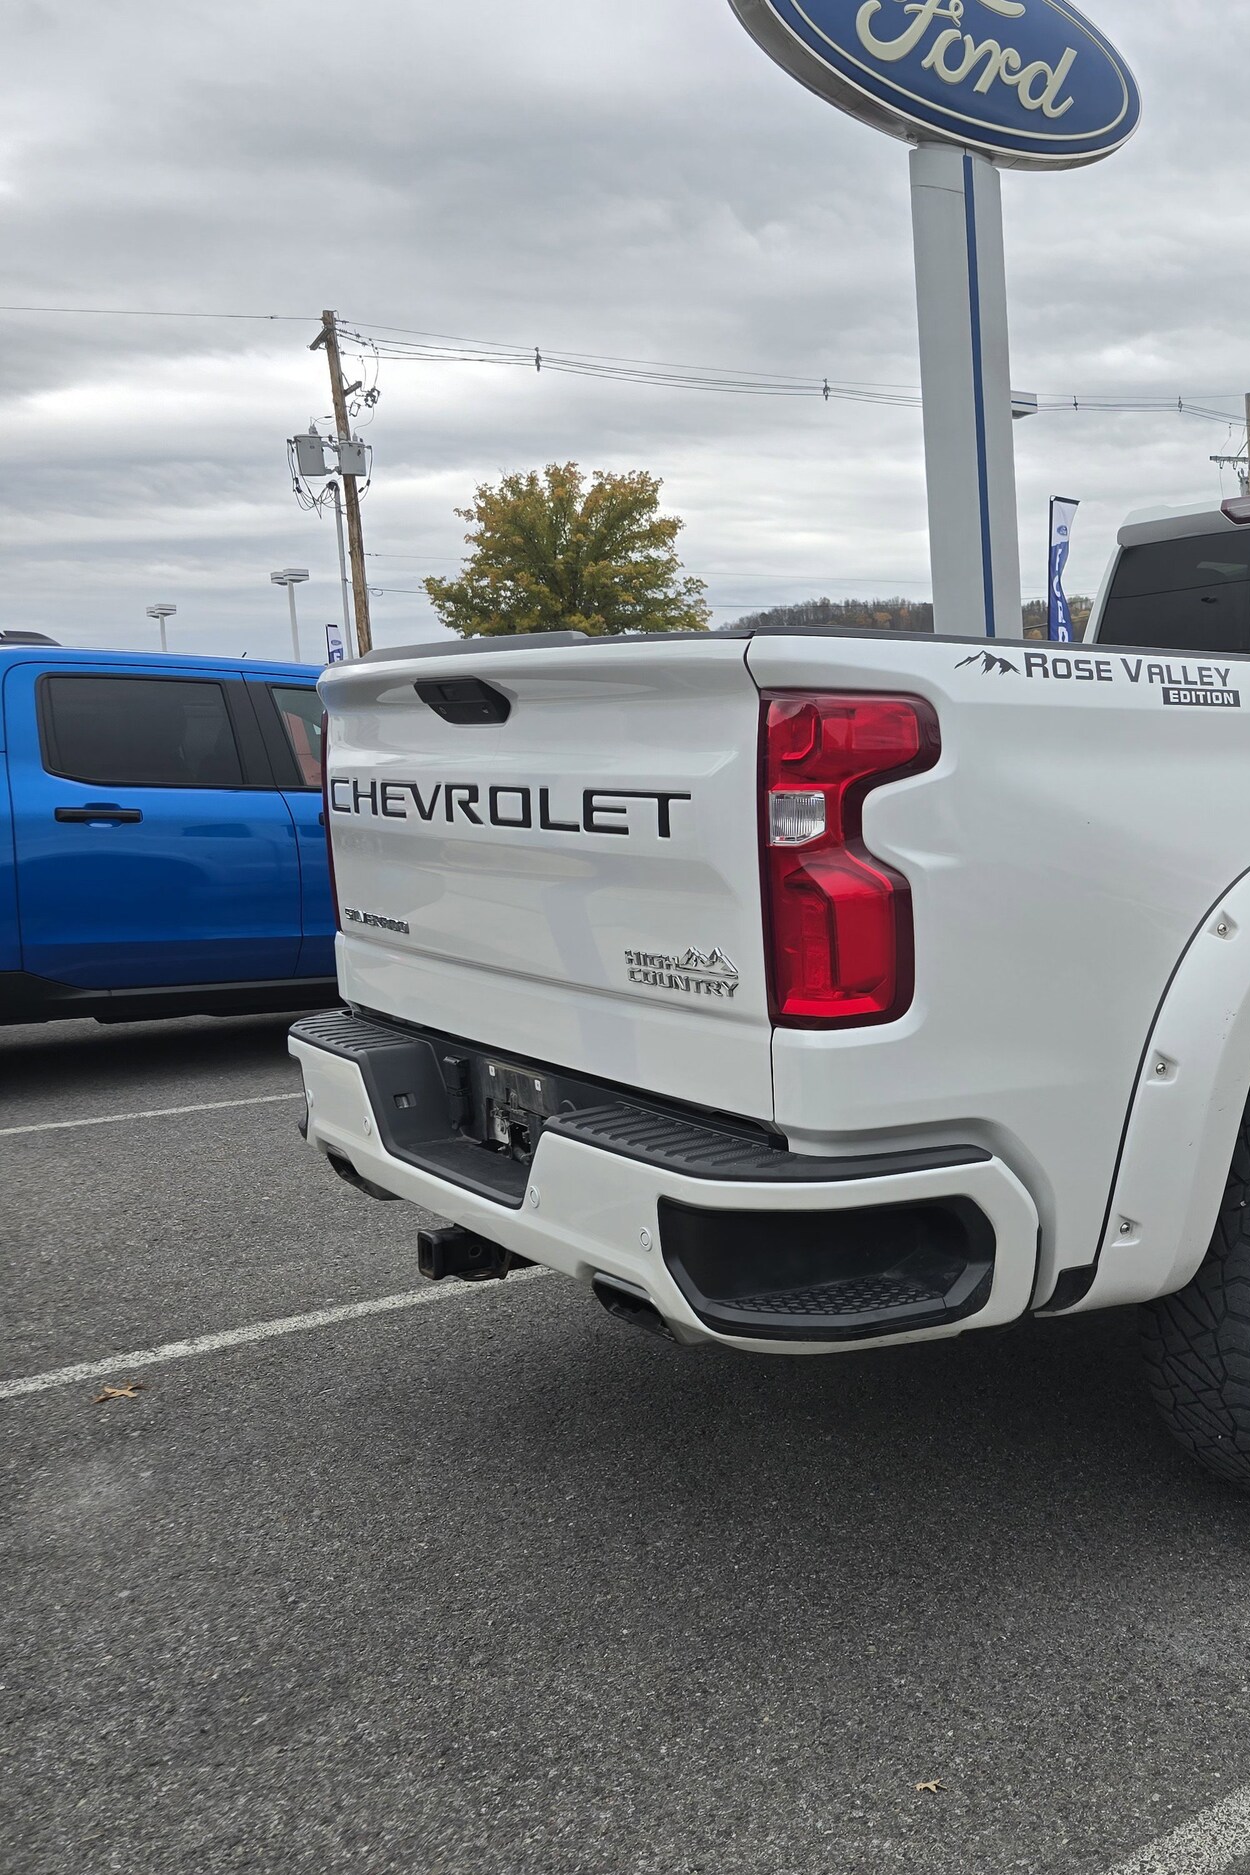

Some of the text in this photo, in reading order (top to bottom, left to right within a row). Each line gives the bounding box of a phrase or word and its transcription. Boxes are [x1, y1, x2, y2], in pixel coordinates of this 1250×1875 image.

[856, 0, 1078, 118] Ford
[1024, 652, 1231, 687] ROSE VALLEY
[1168, 689, 1235, 705] EDITION
[329, 777, 692, 839] CHEVROLET
[624, 949, 681, 971] HIGH
[627, 967, 739, 998] COUNTRY
